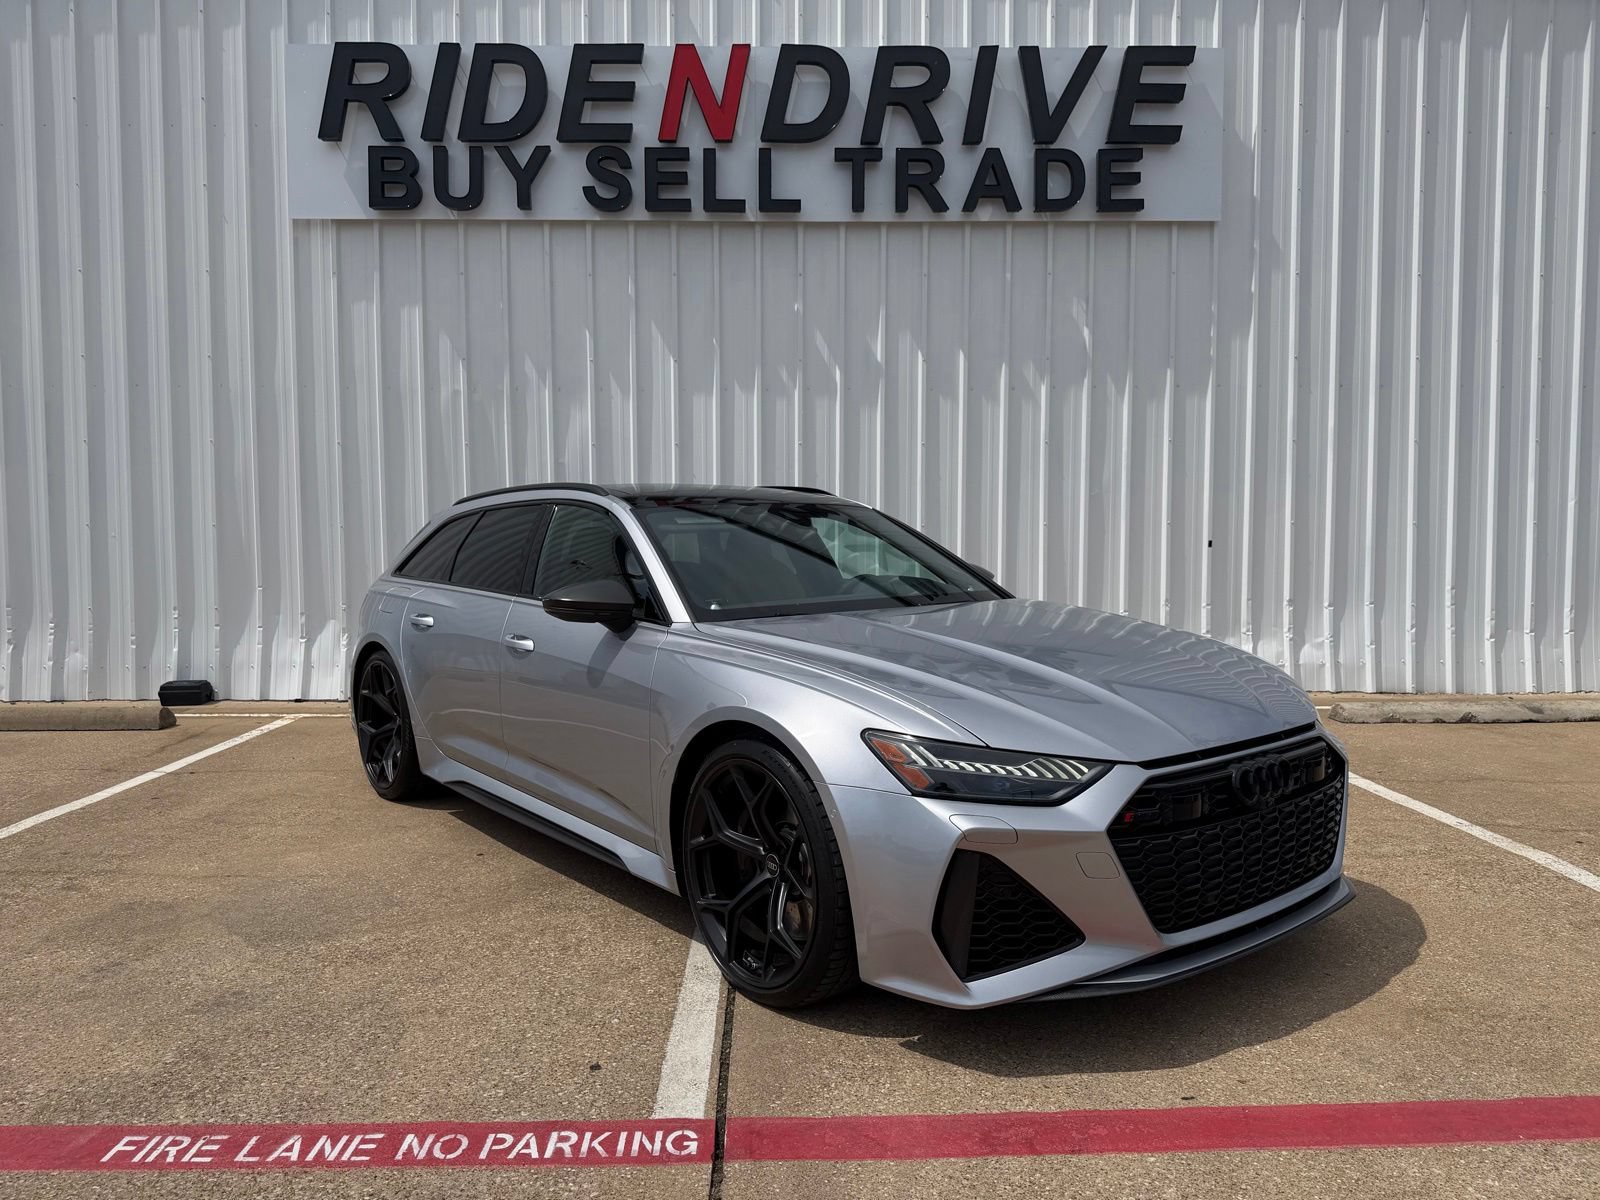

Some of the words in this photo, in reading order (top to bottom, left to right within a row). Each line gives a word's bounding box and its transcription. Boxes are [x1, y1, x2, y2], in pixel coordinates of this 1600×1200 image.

[318, 42, 1196, 145] RIDENDRIVE
[368, 145, 551, 211] BUY
[582, 146, 801, 213] SELL
[834, 147, 1145, 213] TRADE
[100, 1134, 229, 1163] FIRE
[234, 1132, 384, 1162] LANE
[395, 1133, 470, 1161] NO
[478, 1129, 699, 1160] PARKING
